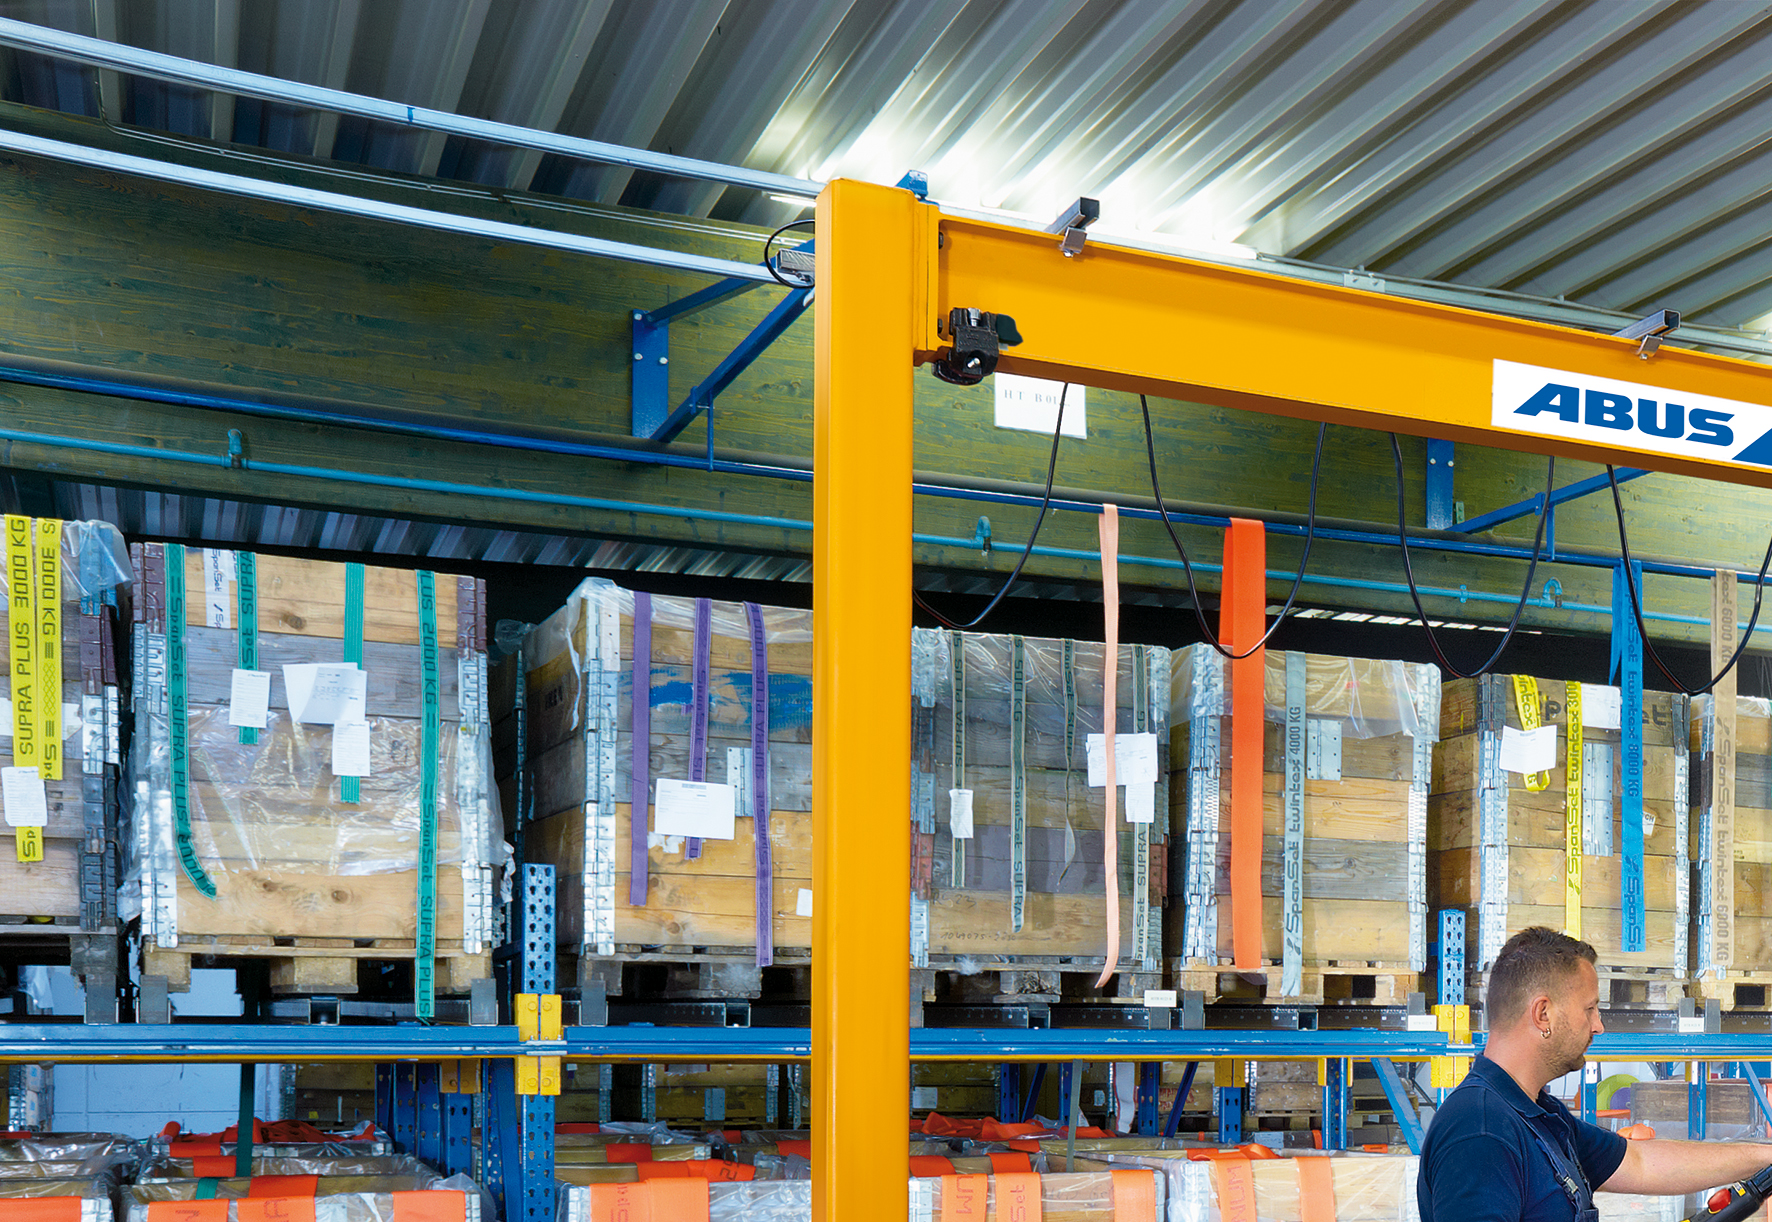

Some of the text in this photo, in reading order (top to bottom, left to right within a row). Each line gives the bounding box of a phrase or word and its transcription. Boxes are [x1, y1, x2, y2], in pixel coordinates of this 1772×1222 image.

[1513, 382, 1735, 447] ABUS
[10, 518, 27, 548] KG
[12, 554, 30, 609] 3000
[41, 547, 56, 600] 3000
[239, 552, 255, 616] SUPRA
[15, 621, 31, 676] PLUS
[41, 608, 56, 636] KG
[170, 597, 184, 682] SpanSet
[422, 622, 436, 672] 2000
[1721, 607, 1733, 642] 6000
[424, 679, 437, 705] KG
[953, 658, 964, 702] PLUS
[1012, 659, 1024, 692] 500
[17, 684, 34, 755] SUPRA
[171, 695, 186, 761] SUPRA
[1627, 670, 1639, 740] twintex
[755, 721, 765, 779] SUPRA
[953, 708, 964, 768] SUPRA
[1567, 710, 1580, 783] twintex
[1627, 743, 1640, 776] 8000
[173, 770, 188, 823] PLUS
[1627, 779, 1640, 797] KG
[1012, 776, 1024, 918] SpanSet SUPRA
[1285, 706, 1303, 934] SpanSet twintex 4000 KG
[1566, 787, 1582, 875] SpanSet
[1136, 830, 1147, 886] SUPRA
[1716, 739, 1732, 961] SpanSet twintex 6000 KG
[418, 802, 435, 1015] SpanSet SUPRA PLUS
